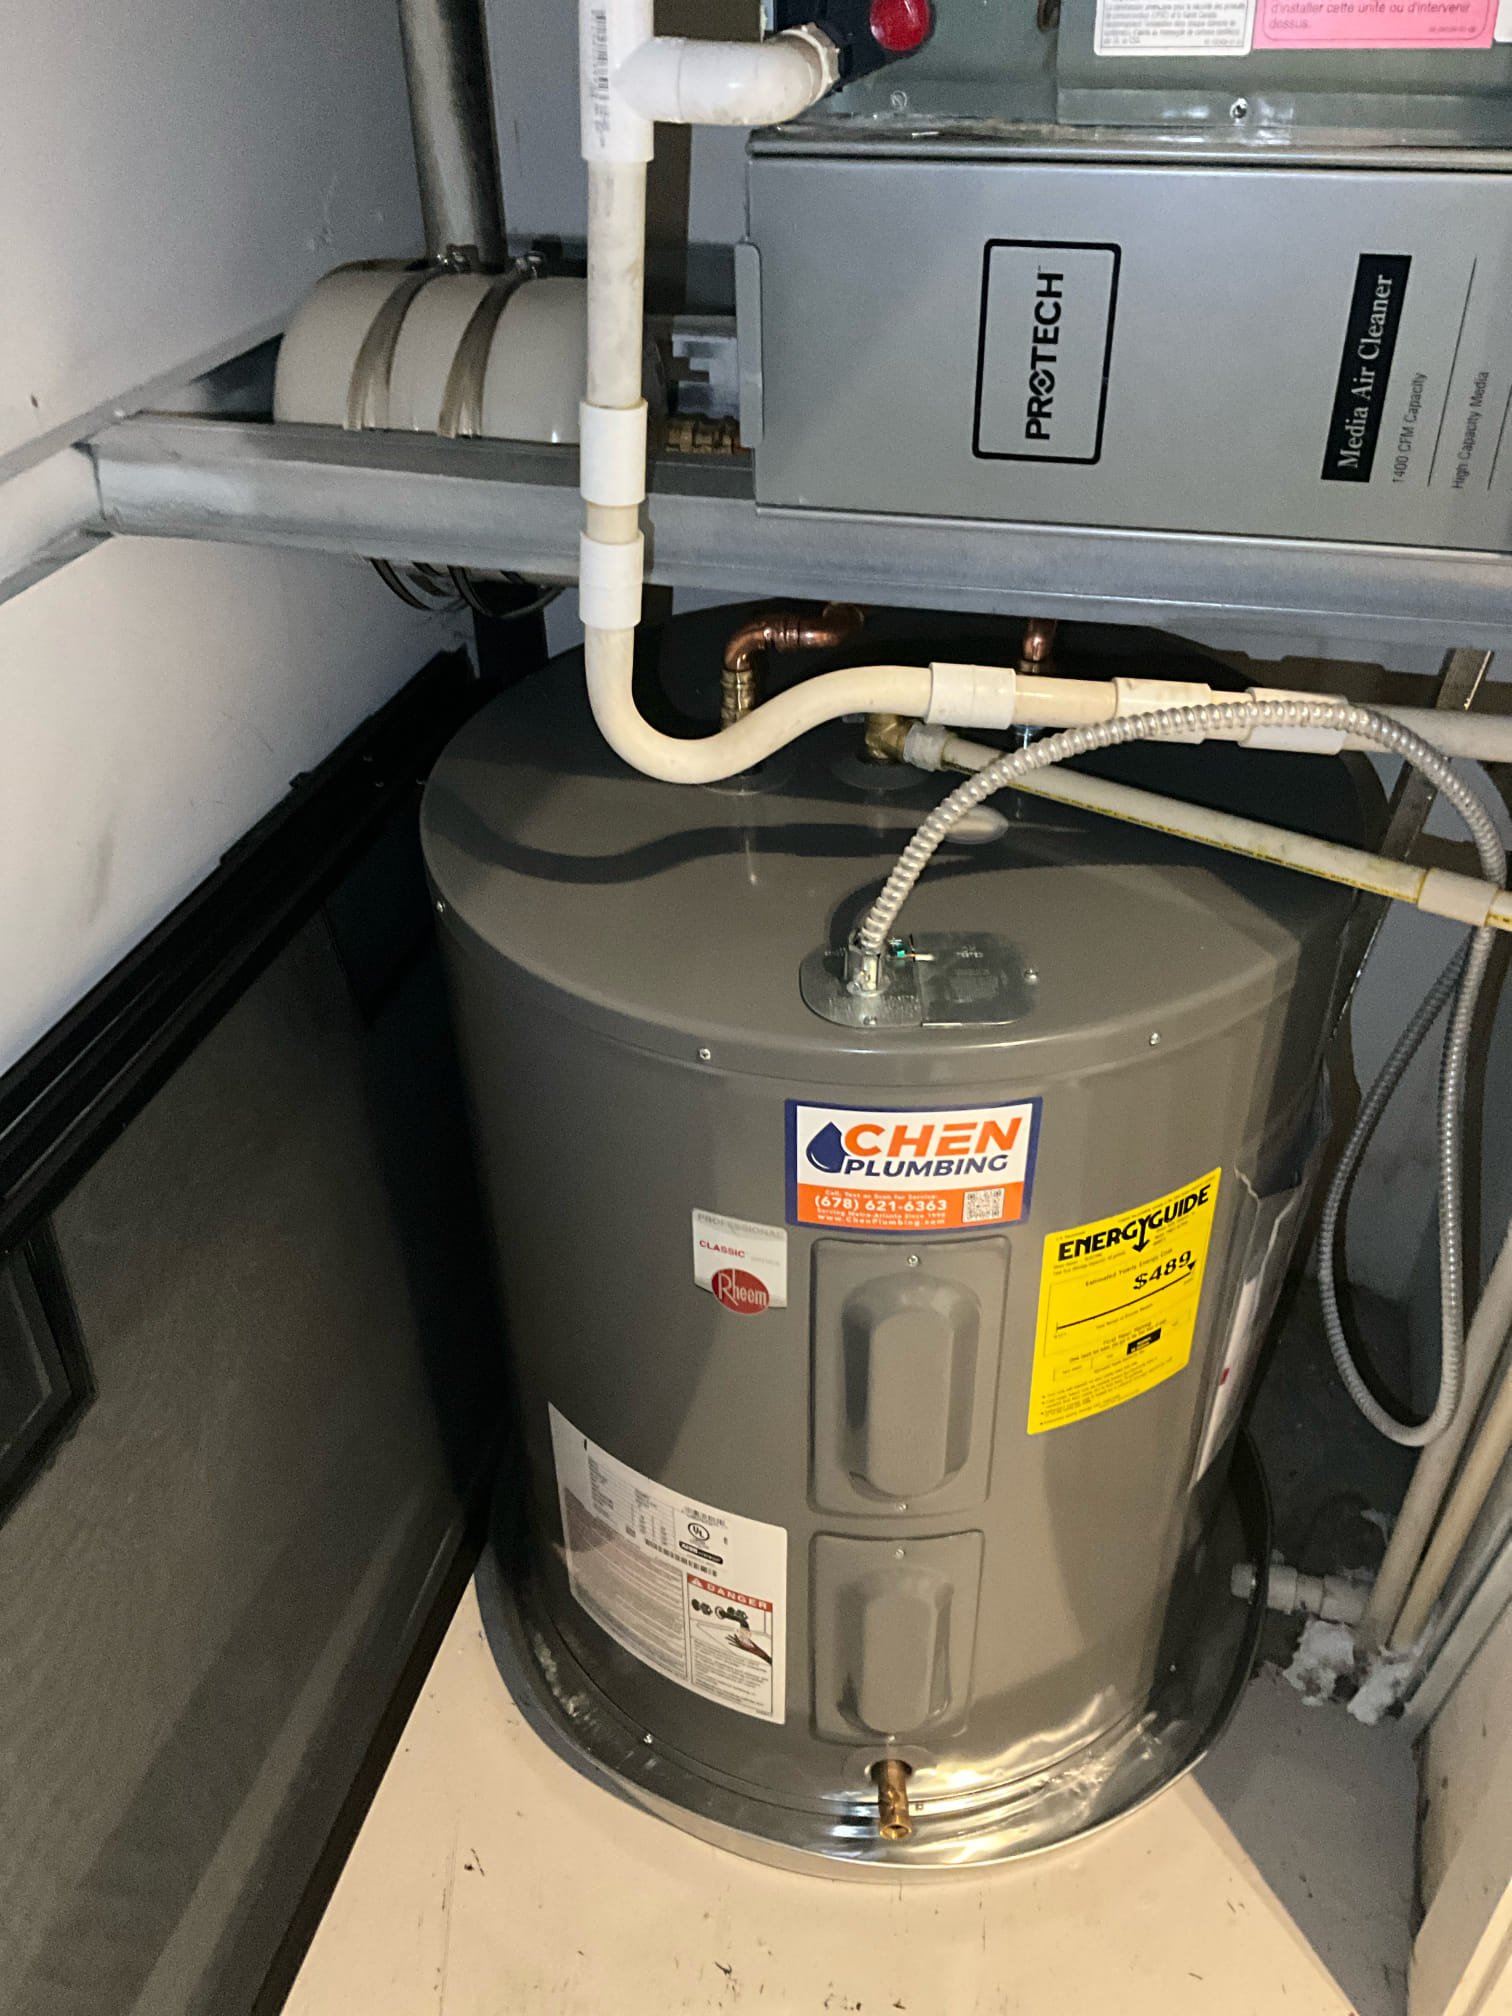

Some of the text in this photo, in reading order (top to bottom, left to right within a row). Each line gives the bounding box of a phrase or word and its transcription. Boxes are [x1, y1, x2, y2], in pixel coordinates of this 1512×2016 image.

[1326, 2, 1354, 13] cette
[1389, 4, 1404, 13] ou
[1025, 272, 1064, 440] PROTECH
[1336, 274, 1393, 469] Media Air Cleaner
[1392, 372, 1428, 483] 1400 CFM Capacity
[1451, 371, 1490, 489] High Capacity Media
[844, 1117, 1022, 1157] CHEN
[843, 1154, 1009, 1178] PLUMBING
[815, 1195, 947, 1212] (678) 621-6363
[1057, 1184, 1211, 1261] ENERGYGUIDE
[699, 1239, 746, 1258] CLASSIC
[717, 1268, 767, 1306] Rheem
[1133, 1250, 1191, 1290] $489
[707, 1583, 768, 1609] DANGER
